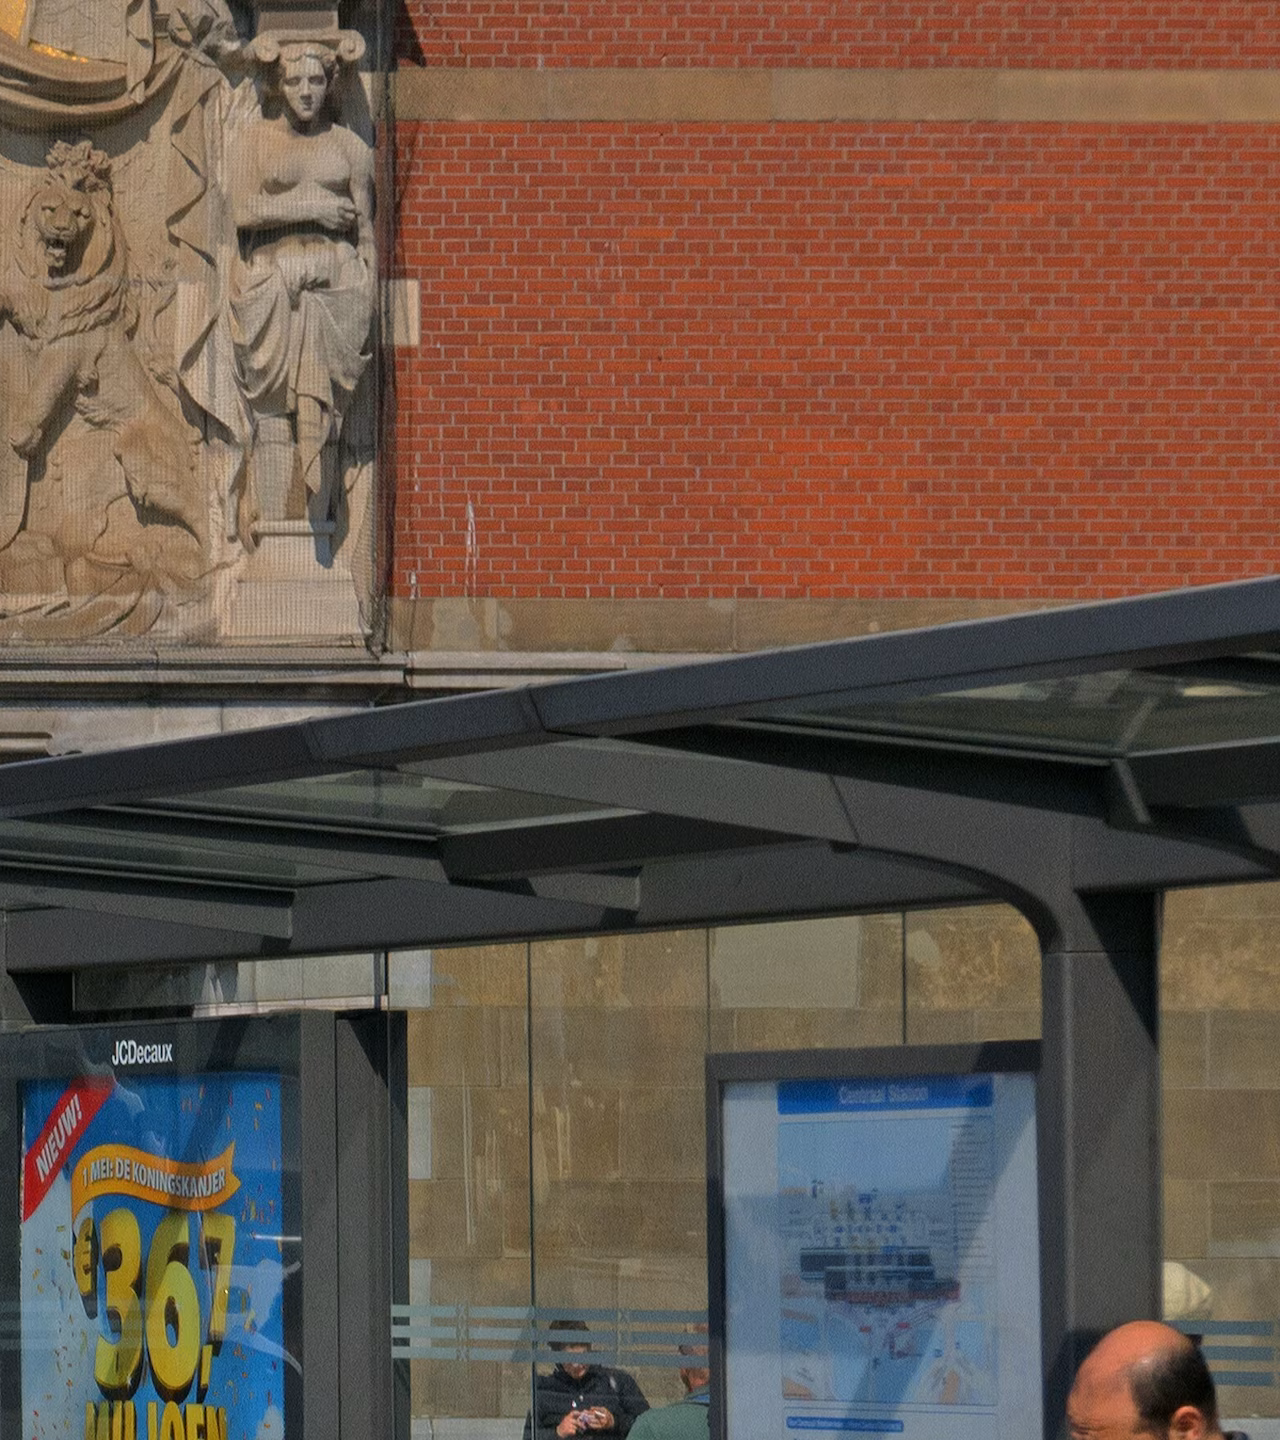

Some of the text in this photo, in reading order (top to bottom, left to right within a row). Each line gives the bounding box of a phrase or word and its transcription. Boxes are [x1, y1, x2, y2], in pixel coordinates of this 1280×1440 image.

[112, 1040, 173, 1065] JCDecaux
[36, 1093, 83, 1183] NIEUW!
[82, 1159, 226, 1199] 1 MEI: DE KONINGSKANJER
